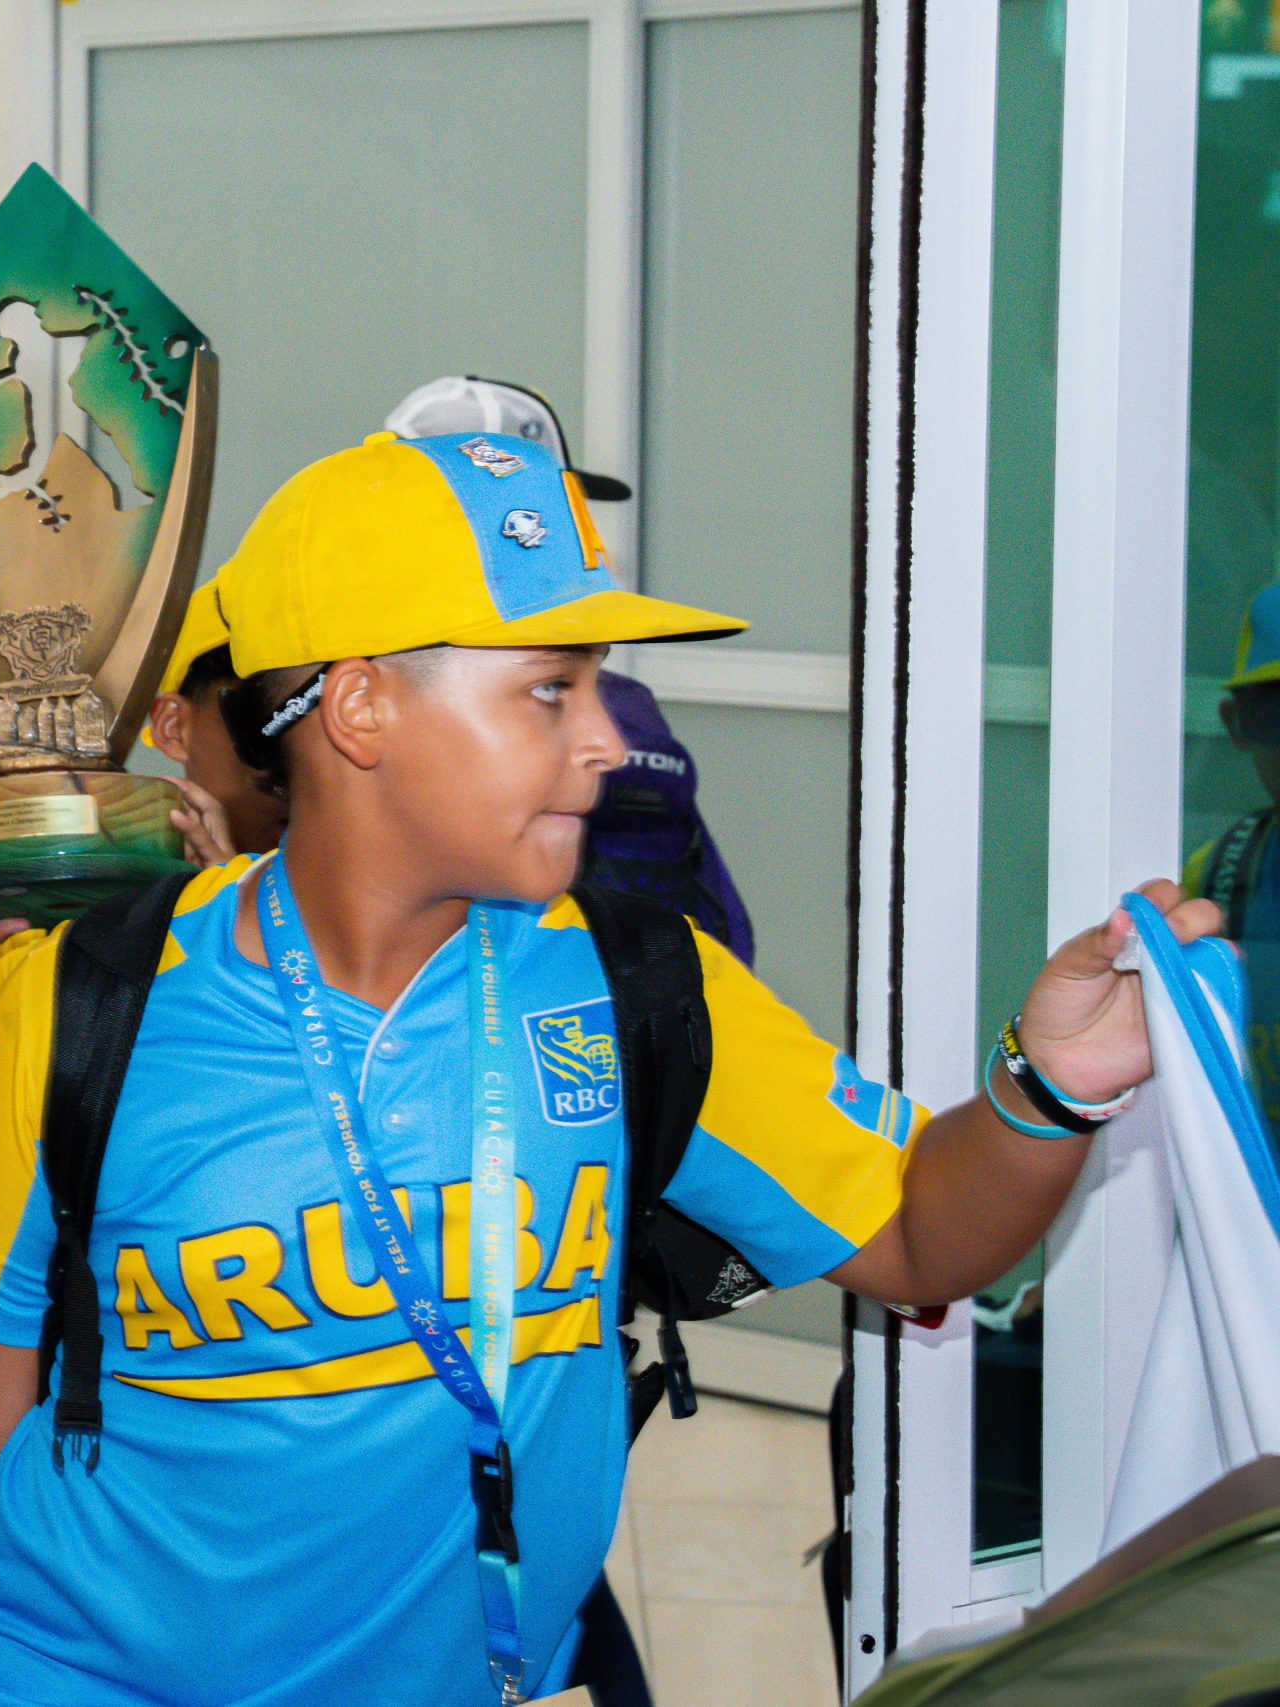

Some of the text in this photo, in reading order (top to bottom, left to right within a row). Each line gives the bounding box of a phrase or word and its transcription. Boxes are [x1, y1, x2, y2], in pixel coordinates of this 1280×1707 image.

[269, 888, 287, 928] FEEL
[479, 927, 496, 957] FOR
[482, 962, 503, 1045] YOURSELF
[553, 1084, 615, 1116] RBC
[327, 1091, 412, 1275] FEEL IT FOR YOURSELF
[114, 1161, 611, 1350] ARUBA
[483, 1223, 499, 1265] FEEL
[483, 1270, 499, 1285] IT
[483, 1291, 498, 1326] FOR
